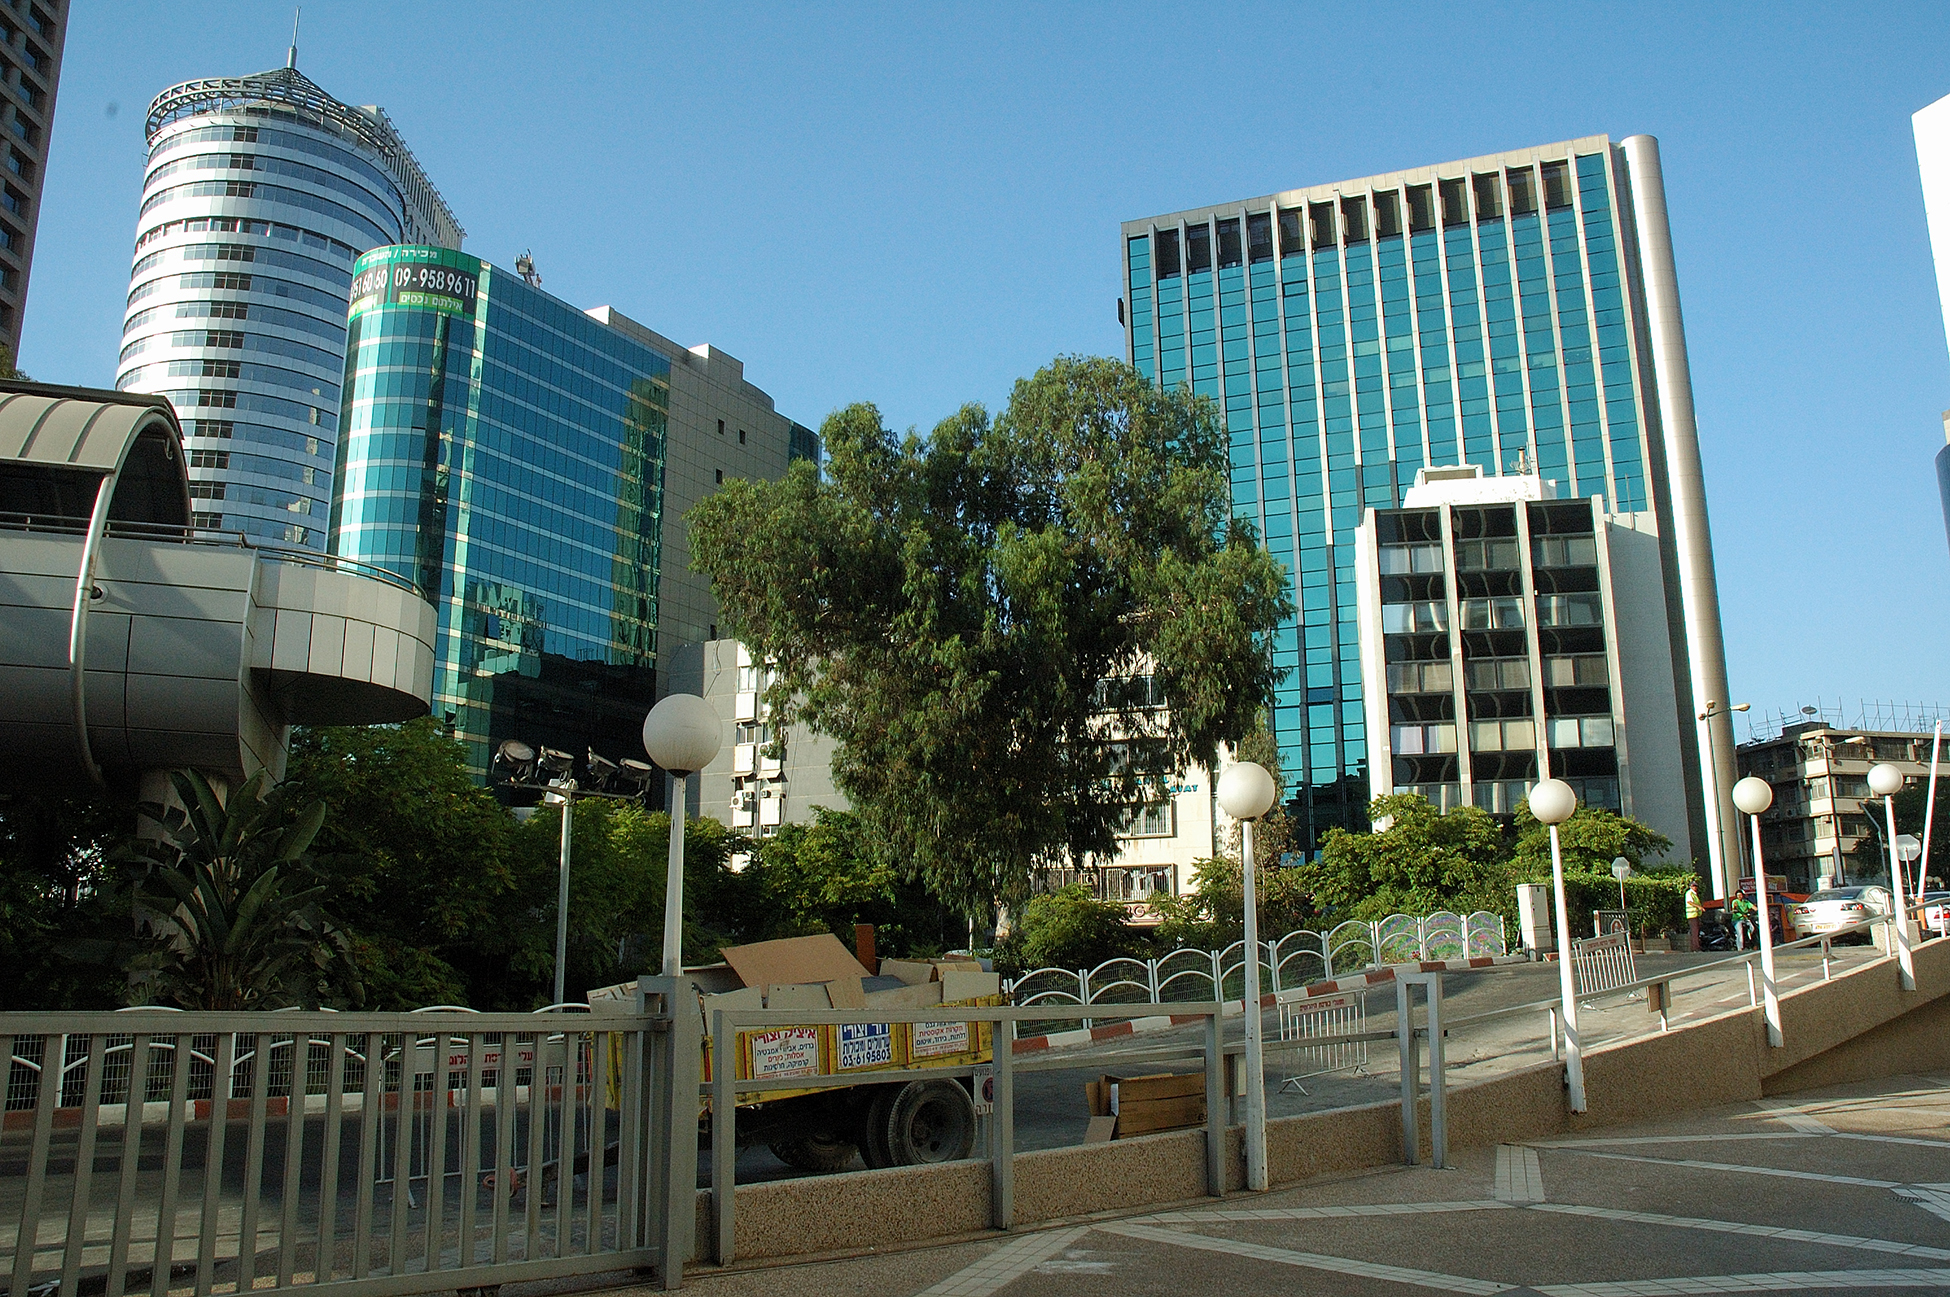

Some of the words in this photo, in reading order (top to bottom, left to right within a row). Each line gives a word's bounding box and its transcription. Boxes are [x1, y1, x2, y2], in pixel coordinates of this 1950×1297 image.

[401, 248, 437, 258] מכירה
[400, 294, 428, 304] נכסים
[784, 1028, 816, 1039] איציק
[449, 1054, 468, 1066] הלומ
[518, 1050, 533, 1061] עלי
[843, 1047, 891, 1067] 03-6195803
